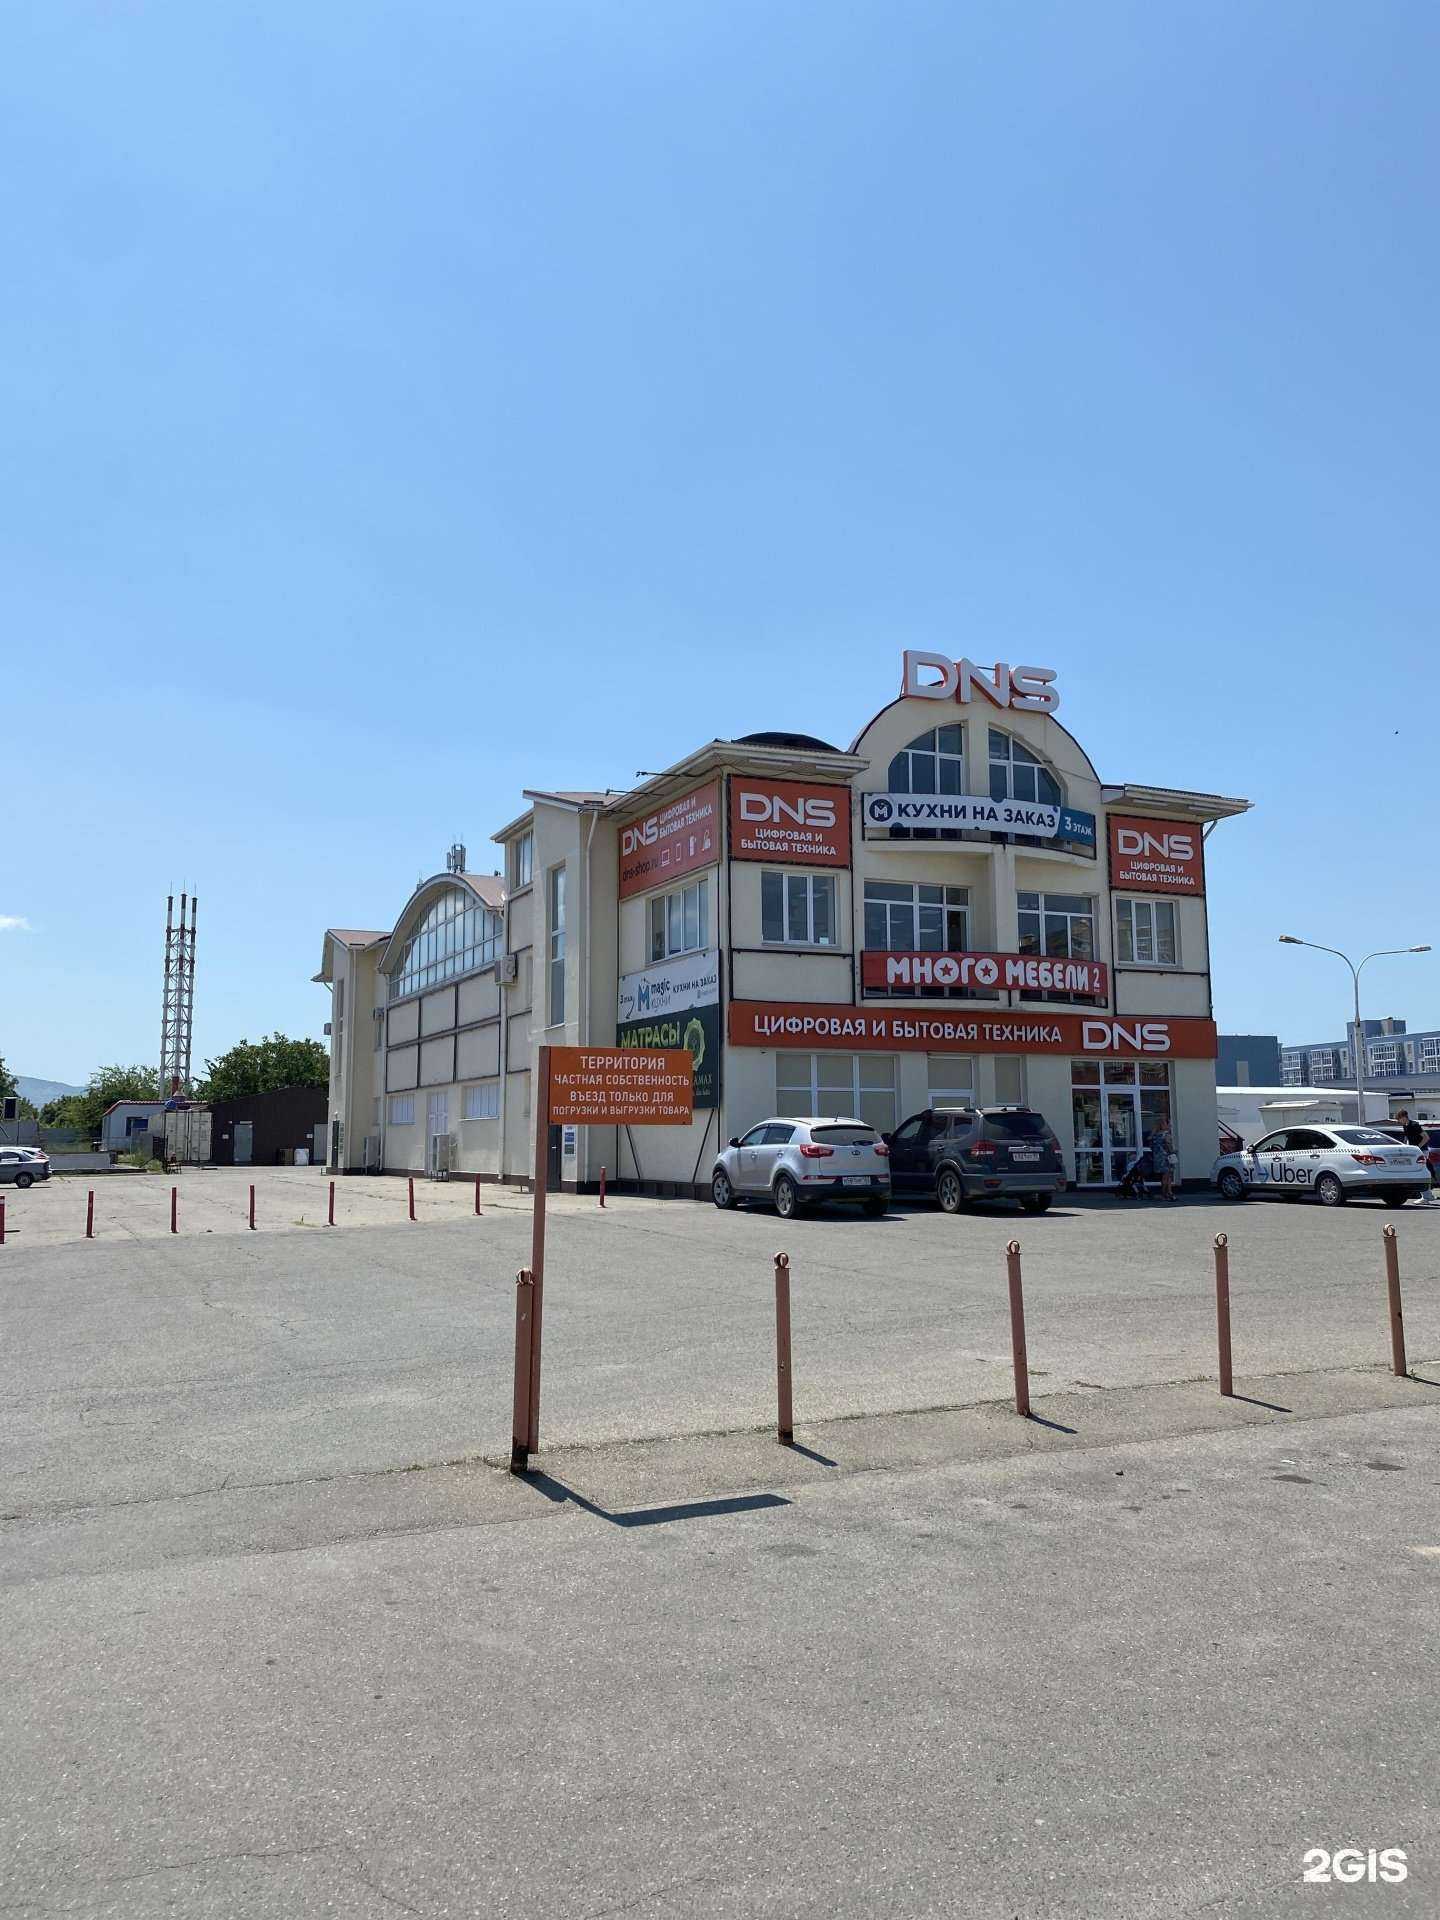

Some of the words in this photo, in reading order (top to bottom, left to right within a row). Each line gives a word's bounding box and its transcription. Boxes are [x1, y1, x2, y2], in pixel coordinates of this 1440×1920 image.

[903, 650, 1060, 713] DNS
[660, 800, 690, 825] ЦИФРОВАЯ
[691, 796, 697, 808] И
[660, 817, 685, 839] БЫТОВАЯ
[686, 803, 713, 827] ТЕХНИКА
[740, 792, 836, 828] DNS
[898, 802, 967, 820] КУХНИ
[973, 805, 999, 822] НА
[1004, 808, 1056, 829] ЗАКАЗ
[623, 816, 659, 857] DNS
[755, 828, 812, 842] ЦИФРОВАЯ
[815, 833, 823, 842] И
[1064, 815, 1072, 831] 3
[1073, 823, 1093, 837] ЭТАЖ
[741, 839, 789, 852] БЫТОВАЯ
[791, 843, 837, 856] ТЕХНИКА
[1118, 829, 1194, 860] DNS
[1119, 871, 1157, 882] БЫТОВАЯ
[1159, 874, 1195, 886] ТЕХНИКА
[1130, 861, 1176, 873] ЦИФРОВАЯ
[1178, 865, 1184, 873] И
[673, 982, 691, 993] КУХНИ
[691, 980, 699, 989] НА
[700, 974, 717, 987] ЗАКАЗ
[886, 957, 999, 984] МНОГО
[1005, 959, 1089, 991] МЕБЕЛИ
[1093, 967, 1101, 988] 2
[621, 1021, 680, 1048] МАТРАСЫ
[754, 1015, 865, 1036] ЦИФРОВАЯ
[872, 1020, 886, 1037] И
[893, 1021, 978, 1040] БЫТОВАЯ
[983, 1024, 1062, 1042] ТЕХНИКА
[1082, 1021, 1171, 1051] DNS
[580, 1056, 665, 1070] ТЕРРИТОРИЯ
[554, 1074, 603, 1085] ЧАСТНАЯ
[606, 1074, 690, 1086] СОБСТВЕННОСТЬ
[570, 1091, 606, 1103] ВЪЕЗД
[609, 1091, 649, 1102] ТОЛЬКО
[652, 1092, 674, 1103] ДЛЯ
[553, 1106, 599, 1115] ПОГРУЗКИ
[601, 1106, 607, 1115] И
[610, 1106, 656, 1116] ВЫГРУЗКИ
[659, 1106, 690, 1115] ТОВАРА
[1271, 1163, 1313, 1183] Uber
